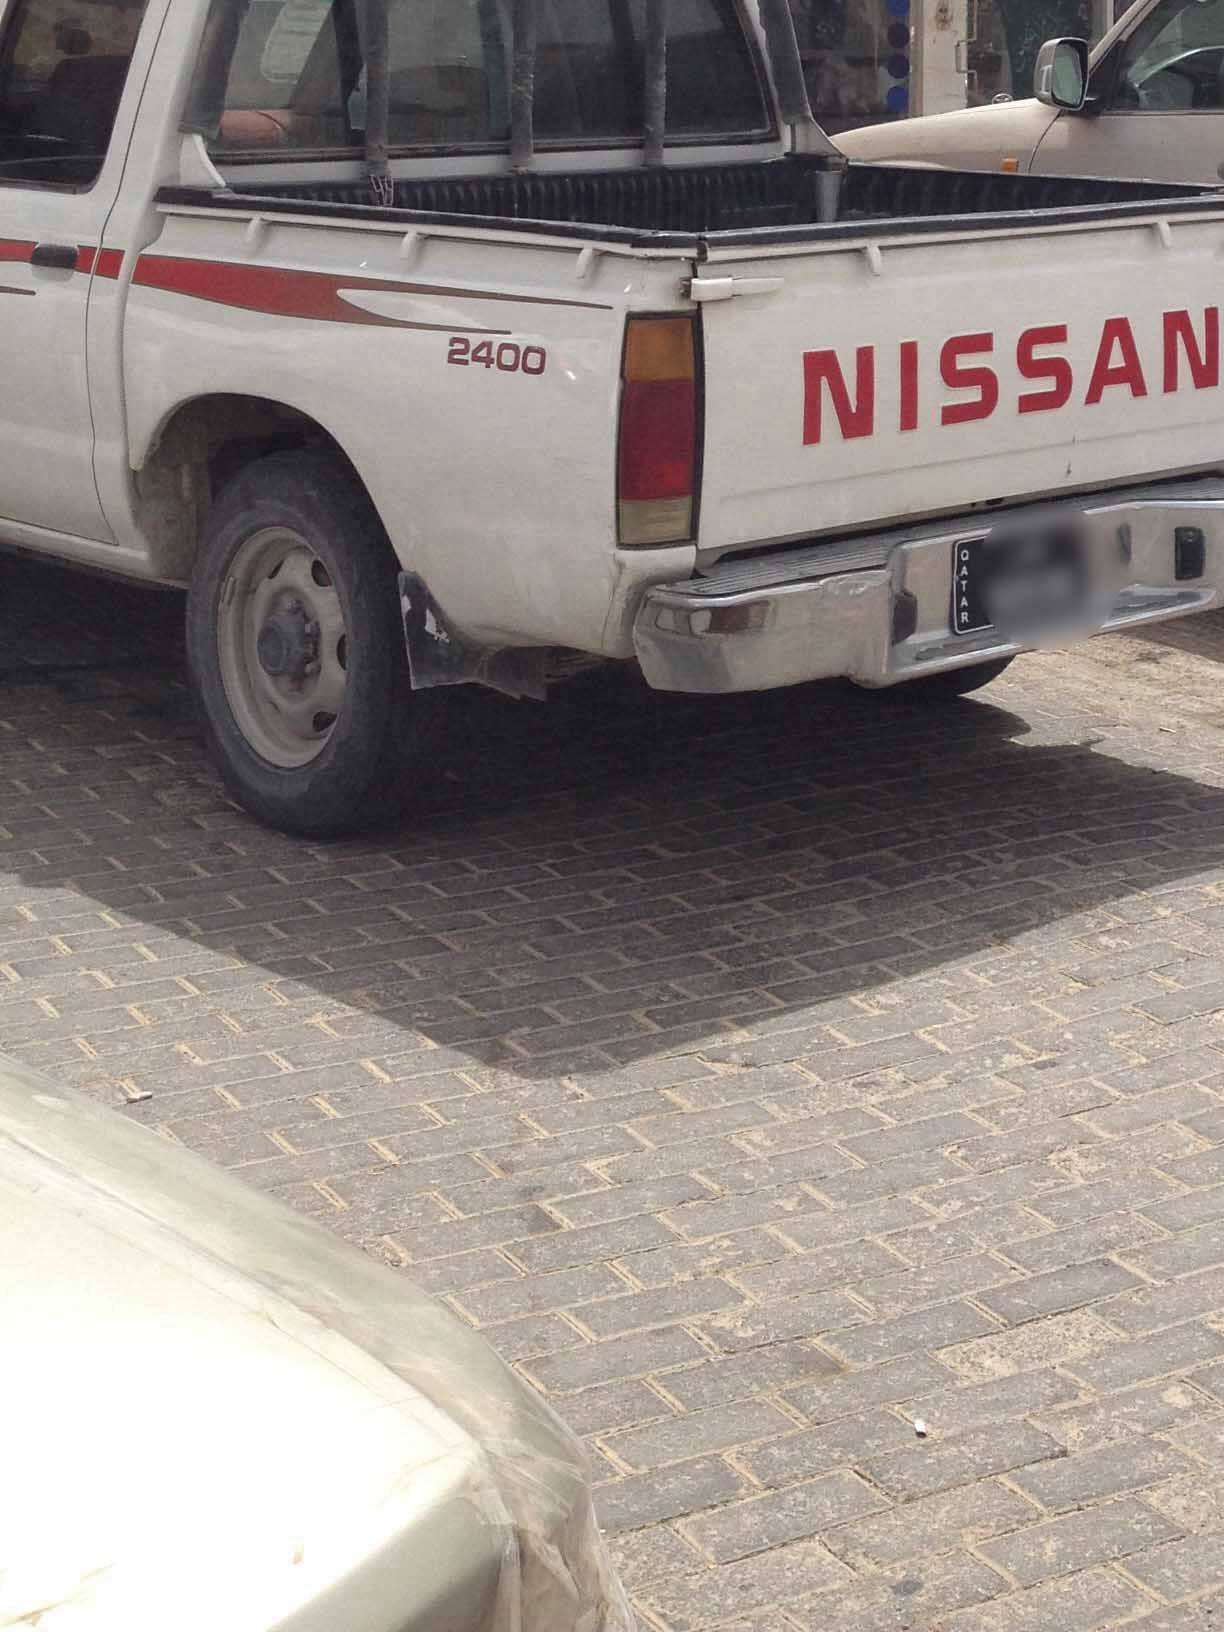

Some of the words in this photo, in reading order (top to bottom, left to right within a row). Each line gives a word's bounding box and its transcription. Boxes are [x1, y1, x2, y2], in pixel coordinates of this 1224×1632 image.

[447, 336, 546, 375] 2400
[802, 306, 1220, 446] NISSAN
[960, 549, 970, 623] QATAR
